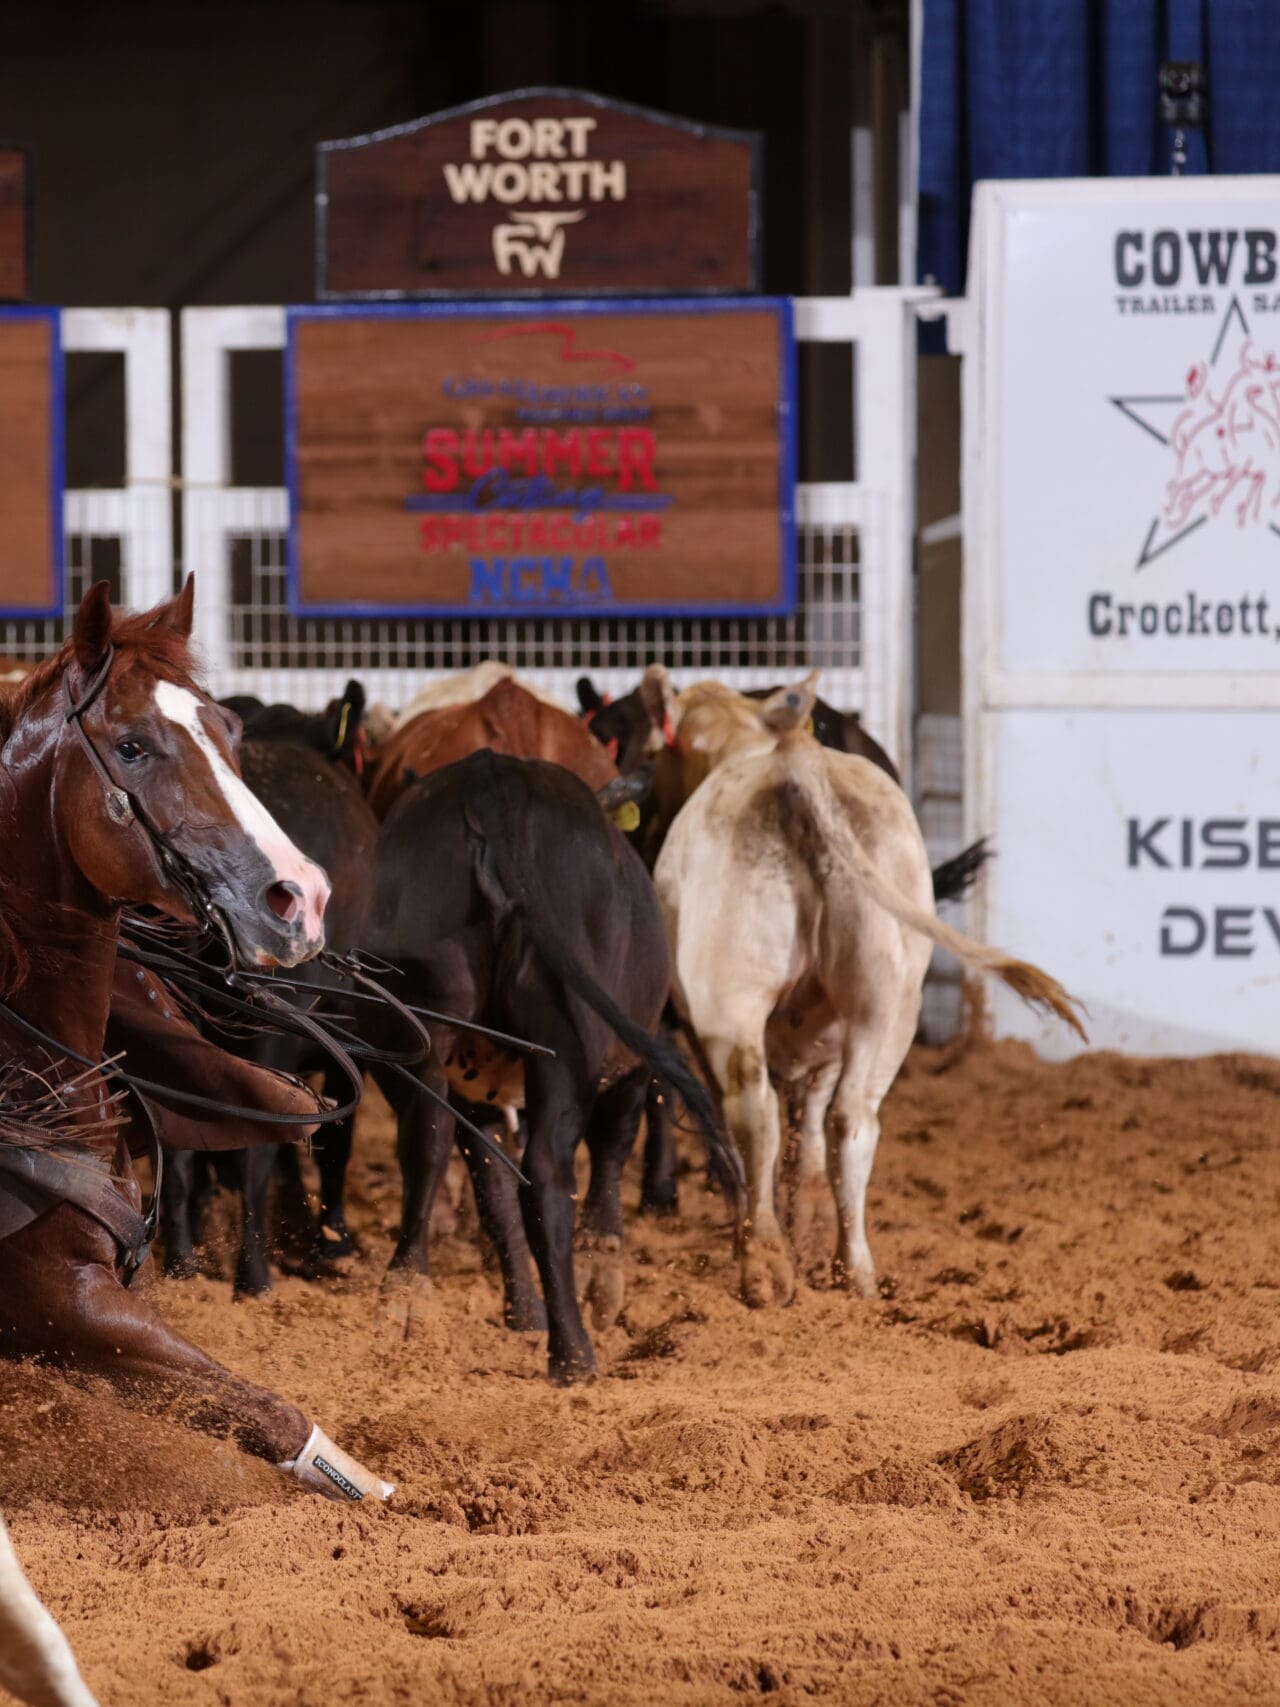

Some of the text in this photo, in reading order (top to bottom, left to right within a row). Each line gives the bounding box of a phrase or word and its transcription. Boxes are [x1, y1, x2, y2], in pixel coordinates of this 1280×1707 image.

[470, 118, 596, 159] FORT
[443, 161, 626, 203] WORTH
[1115, 229, 1277, 288] COWB
[1117, 296, 1215, 314] TRAILER
[424, 428, 659, 491] SUMMER
[421, 513, 662, 551] SPECTACULAR
[314, 1457, 362, 1500] ICONOCLAST
